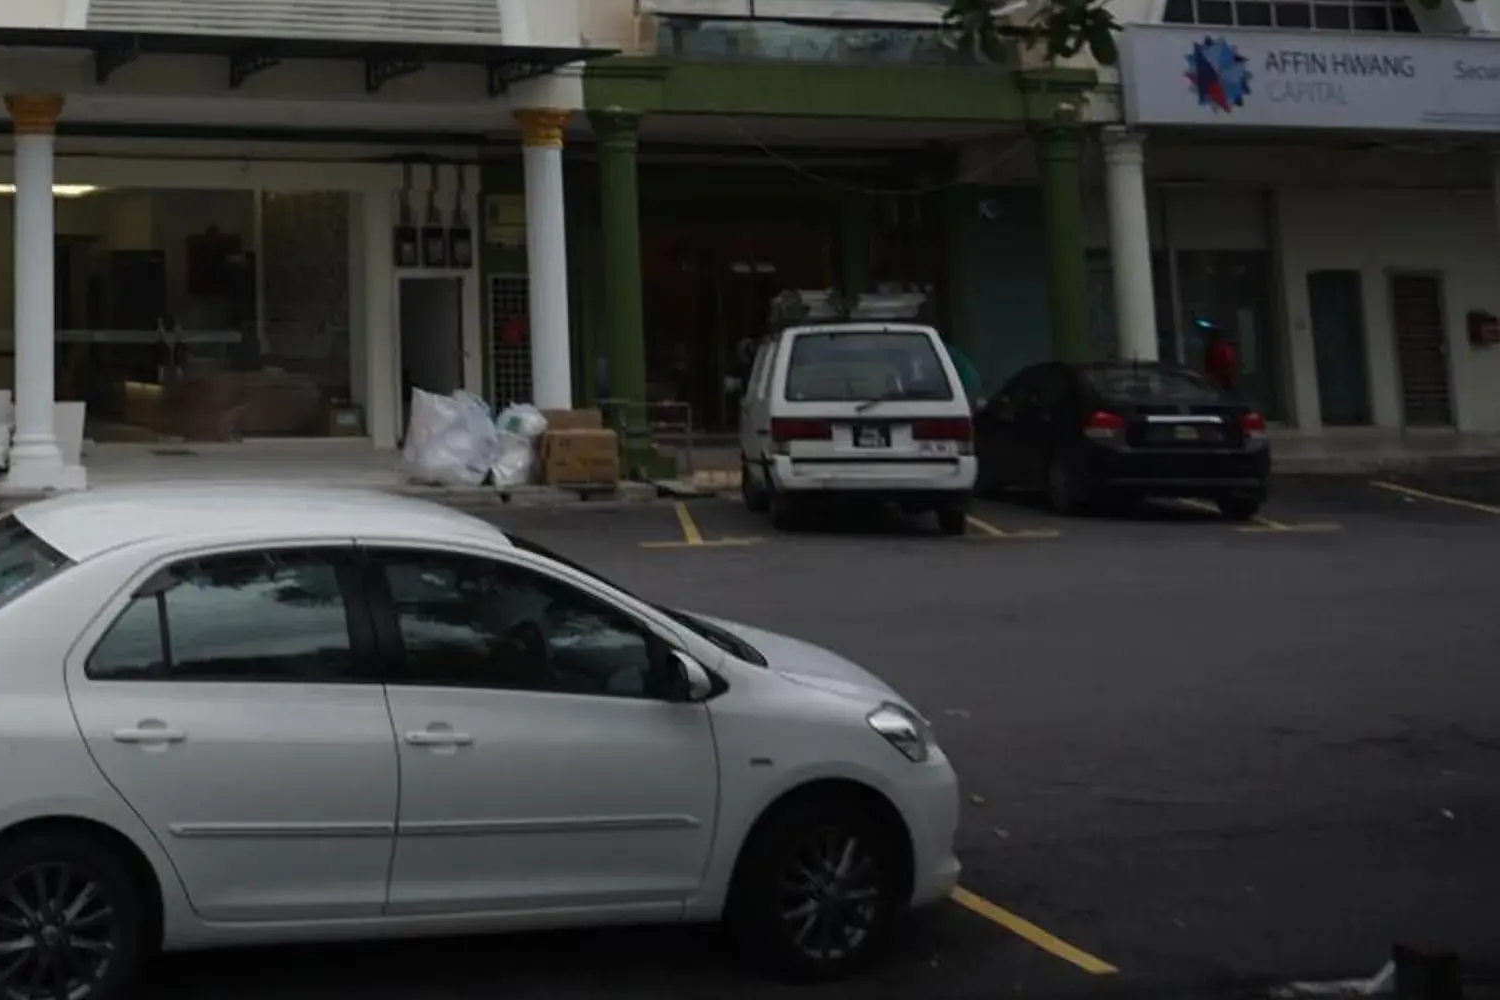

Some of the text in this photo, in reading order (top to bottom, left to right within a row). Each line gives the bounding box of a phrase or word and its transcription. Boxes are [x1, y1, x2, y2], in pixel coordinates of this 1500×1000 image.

[1265, 51, 1329, 76] AFFIN
[1334, 53, 1415, 79] HWANG
[1266, 80, 1348, 106] CAPITAL
